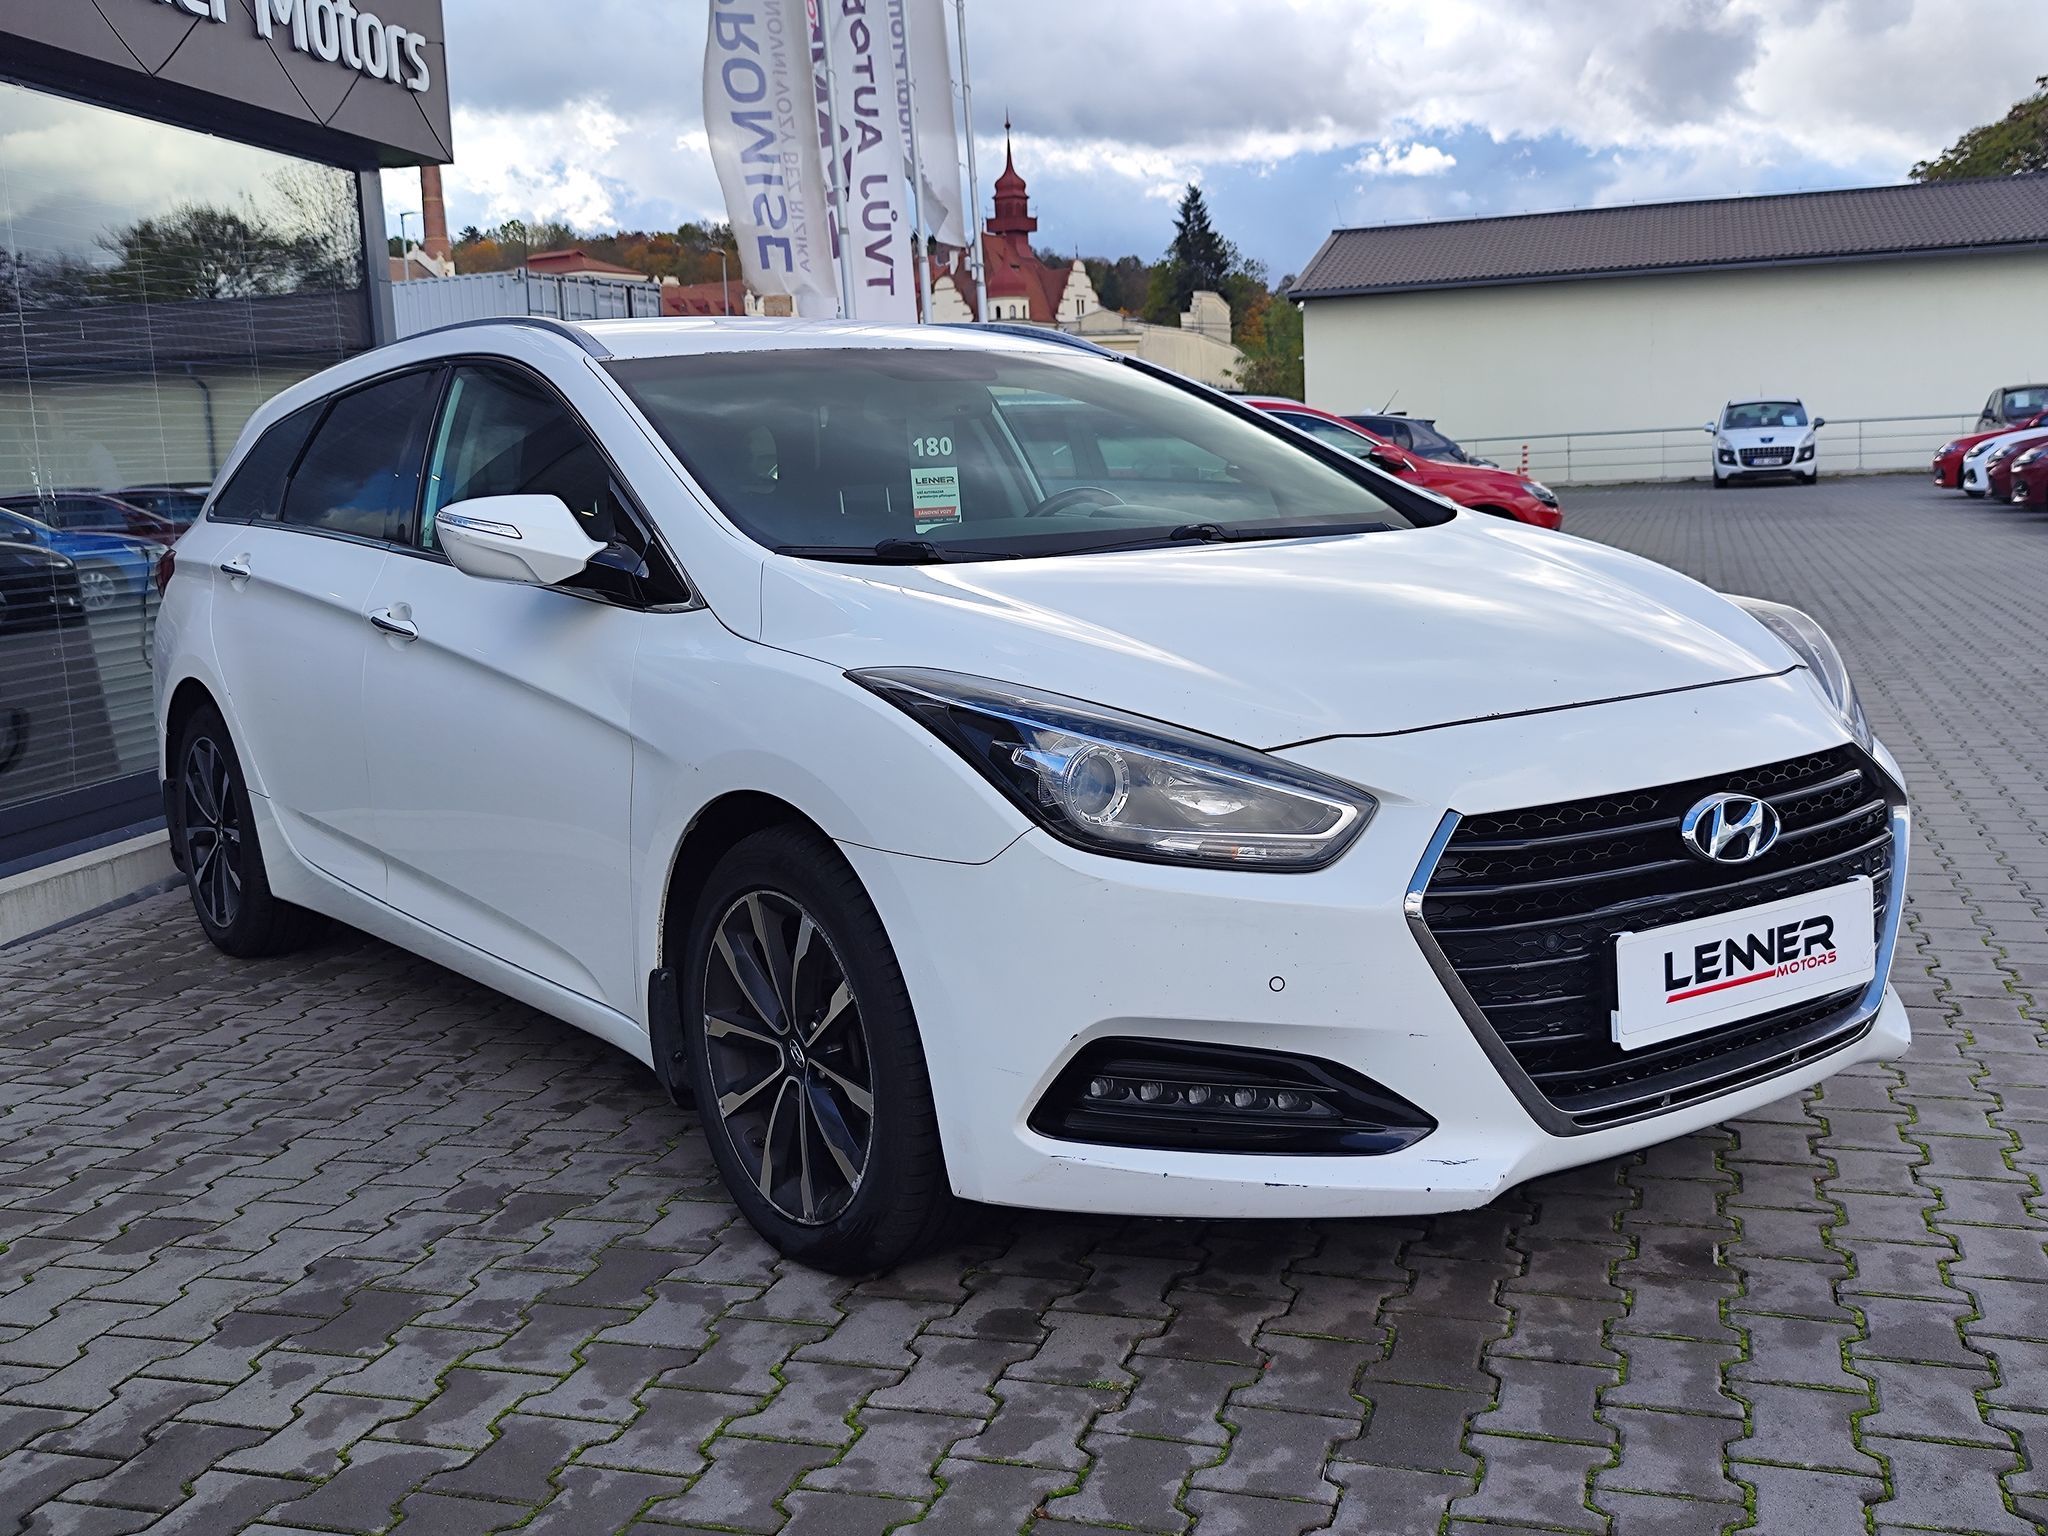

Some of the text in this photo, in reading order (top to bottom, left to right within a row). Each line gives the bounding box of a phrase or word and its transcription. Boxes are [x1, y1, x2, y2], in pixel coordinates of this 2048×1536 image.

[254, 0, 430, 93] Motors
[912, 436, 953, 457] 180
[915, 476, 955, 485] LENNER
[1663, 914, 1836, 992] LENNER
[1775, 950, 1837, 978] MOTORS
